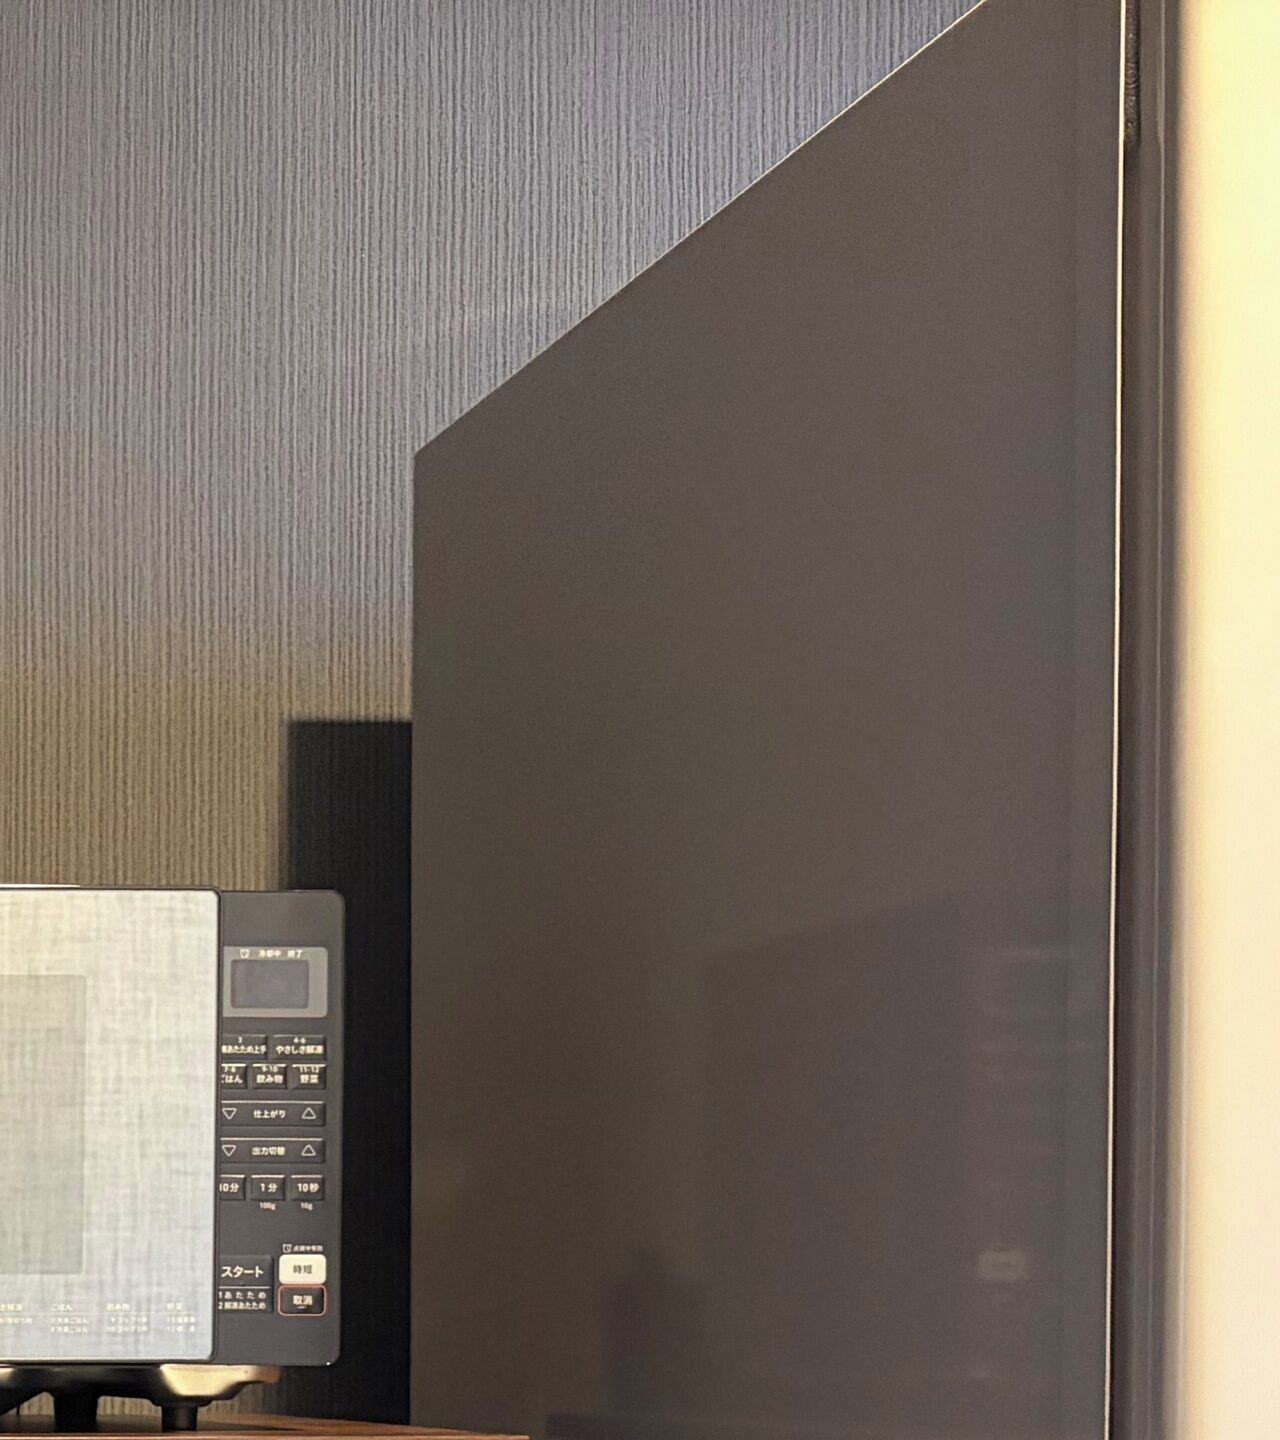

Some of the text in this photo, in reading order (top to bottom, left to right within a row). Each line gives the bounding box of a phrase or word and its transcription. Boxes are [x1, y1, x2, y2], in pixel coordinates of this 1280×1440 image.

[254, 1109, 286, 1118] 仕上がり
[298, 1183, 320, 1192] 10秒
[221, 1266, 264, 1278] スタート
